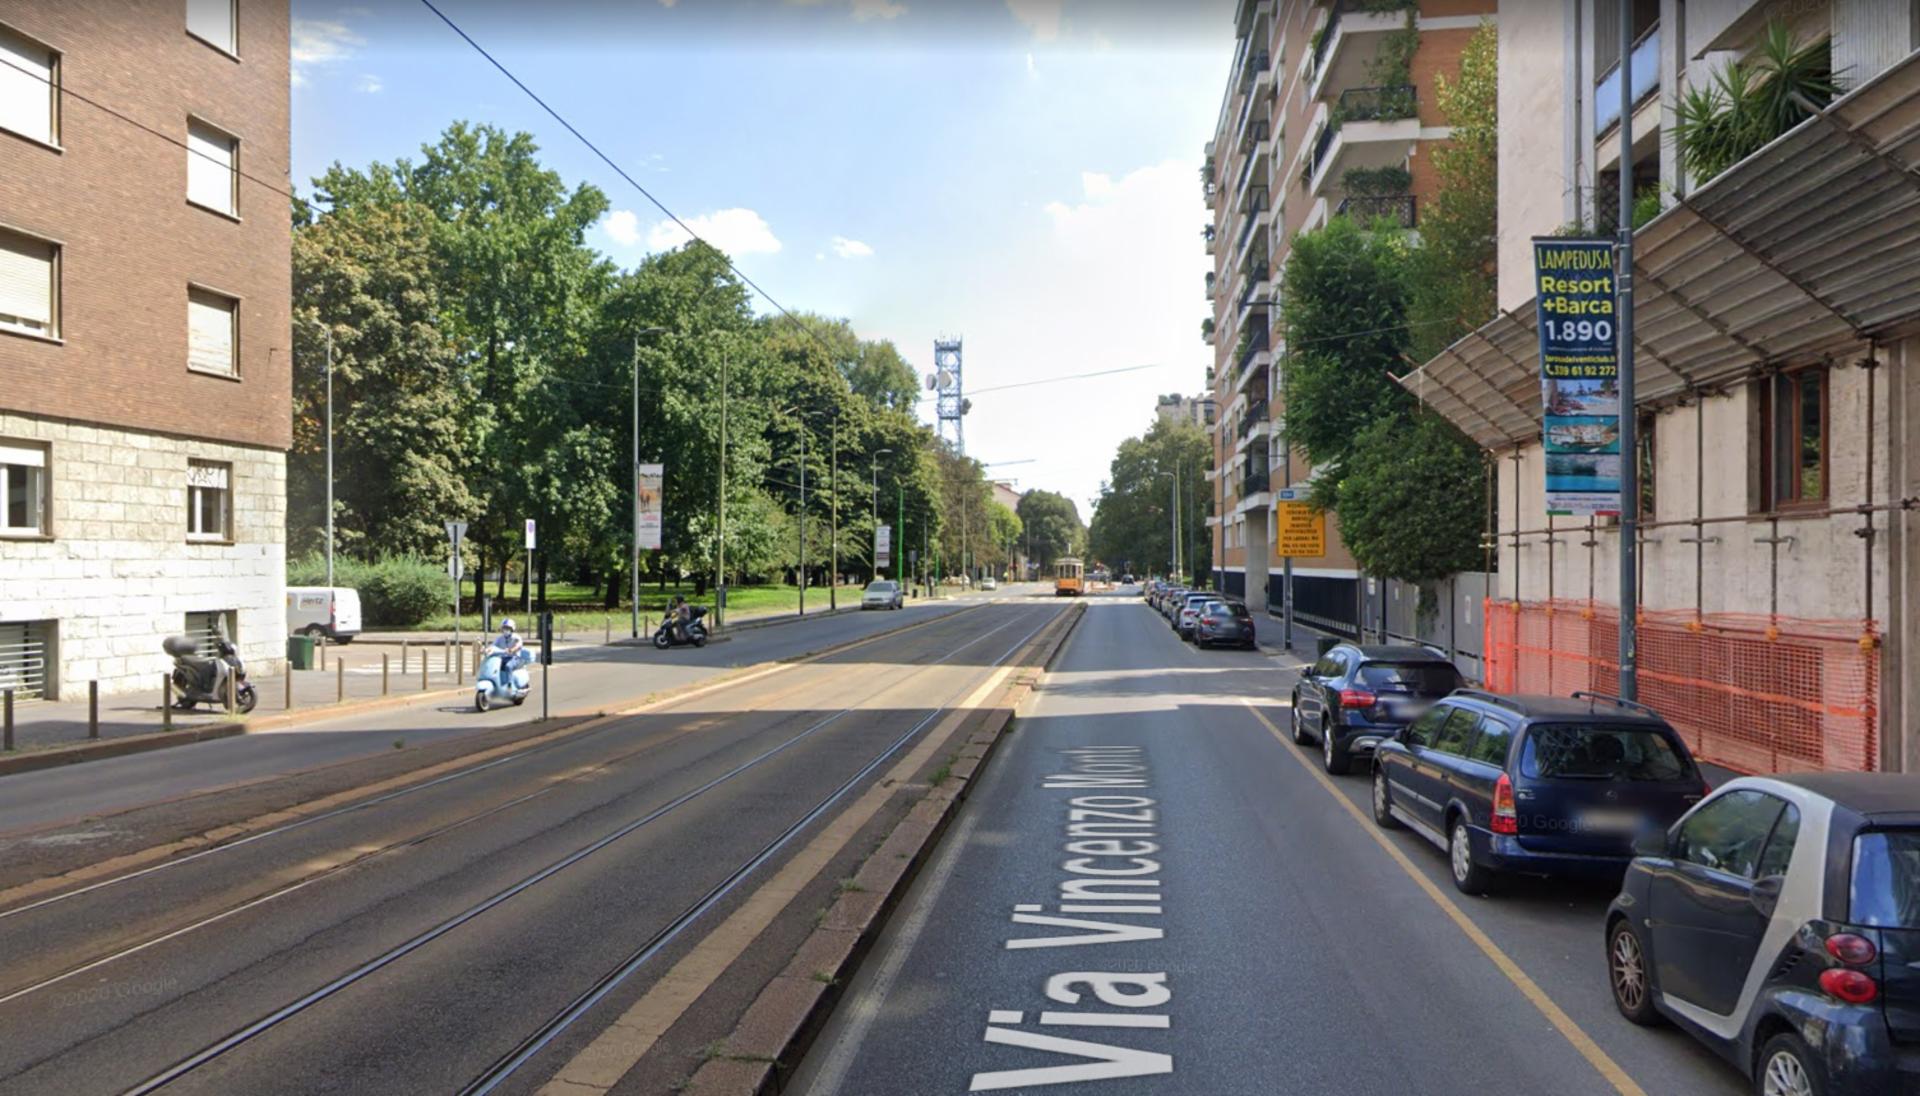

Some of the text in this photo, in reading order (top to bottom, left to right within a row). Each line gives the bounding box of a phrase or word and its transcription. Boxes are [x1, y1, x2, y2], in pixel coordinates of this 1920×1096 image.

[1538, 247, 1612, 269] LAMPEDUSA
[1541, 276, 1612, 293] Resort
[1543, 296, 1613, 314] +Barca
[1545, 320, 1612, 341] 1.890
[1584, 365, 1597, 376] 92
[1599, 365, 1616, 376] 272
[1005, 795, 1164, 949] Vincenzo
[969, 971, 1173, 1091] Via
